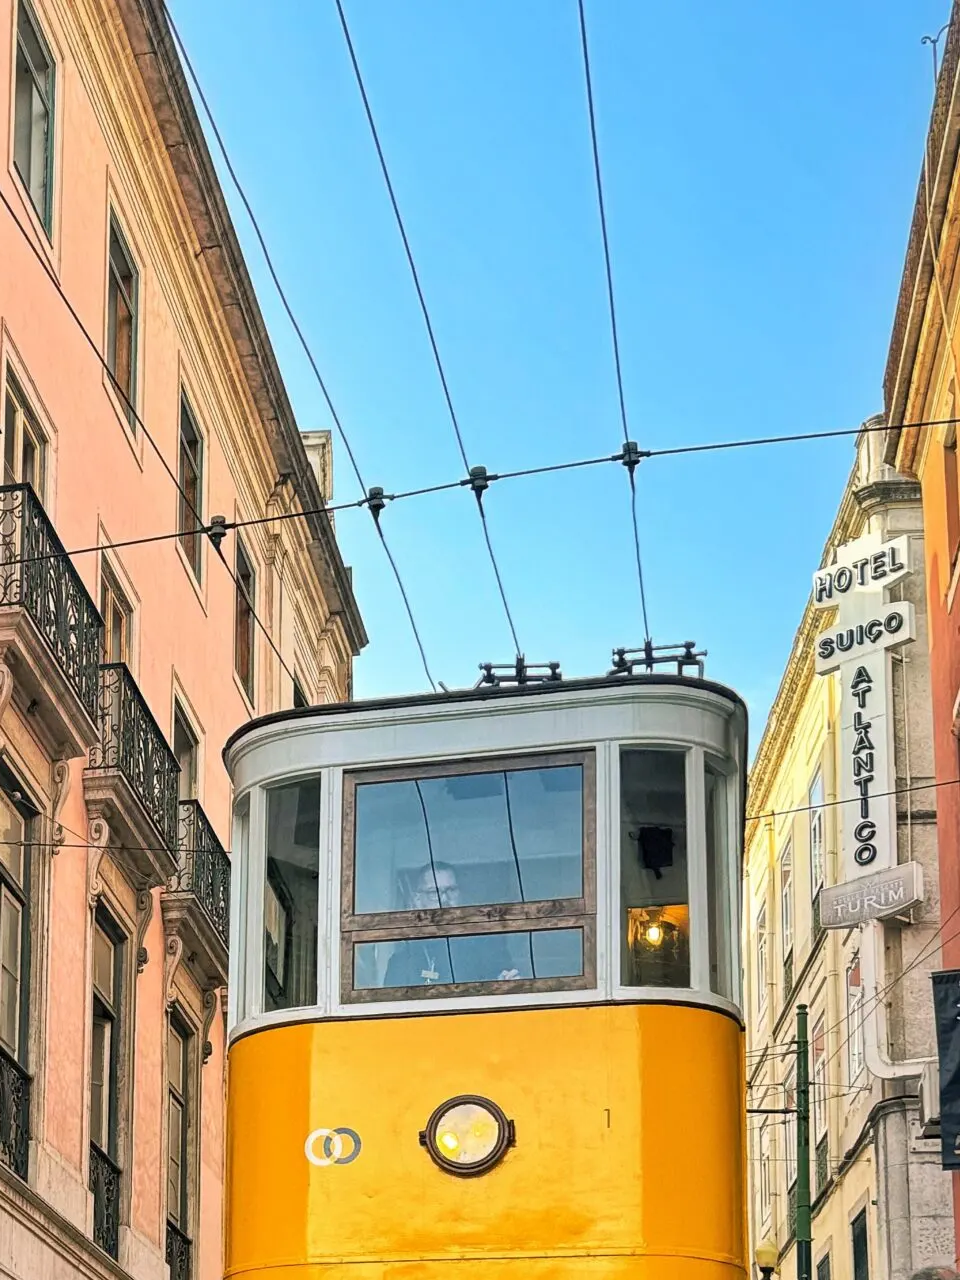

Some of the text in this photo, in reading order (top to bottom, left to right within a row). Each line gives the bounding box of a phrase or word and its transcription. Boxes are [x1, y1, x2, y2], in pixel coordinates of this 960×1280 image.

[814, 546, 904, 603] HOTEL
[818, 611, 904, 660] SUIÇO
[851, 665, 878, 866] ATLÂNTICO
[833, 886, 905, 917] TURIM
[603, 1108, 611, 1129] 1
